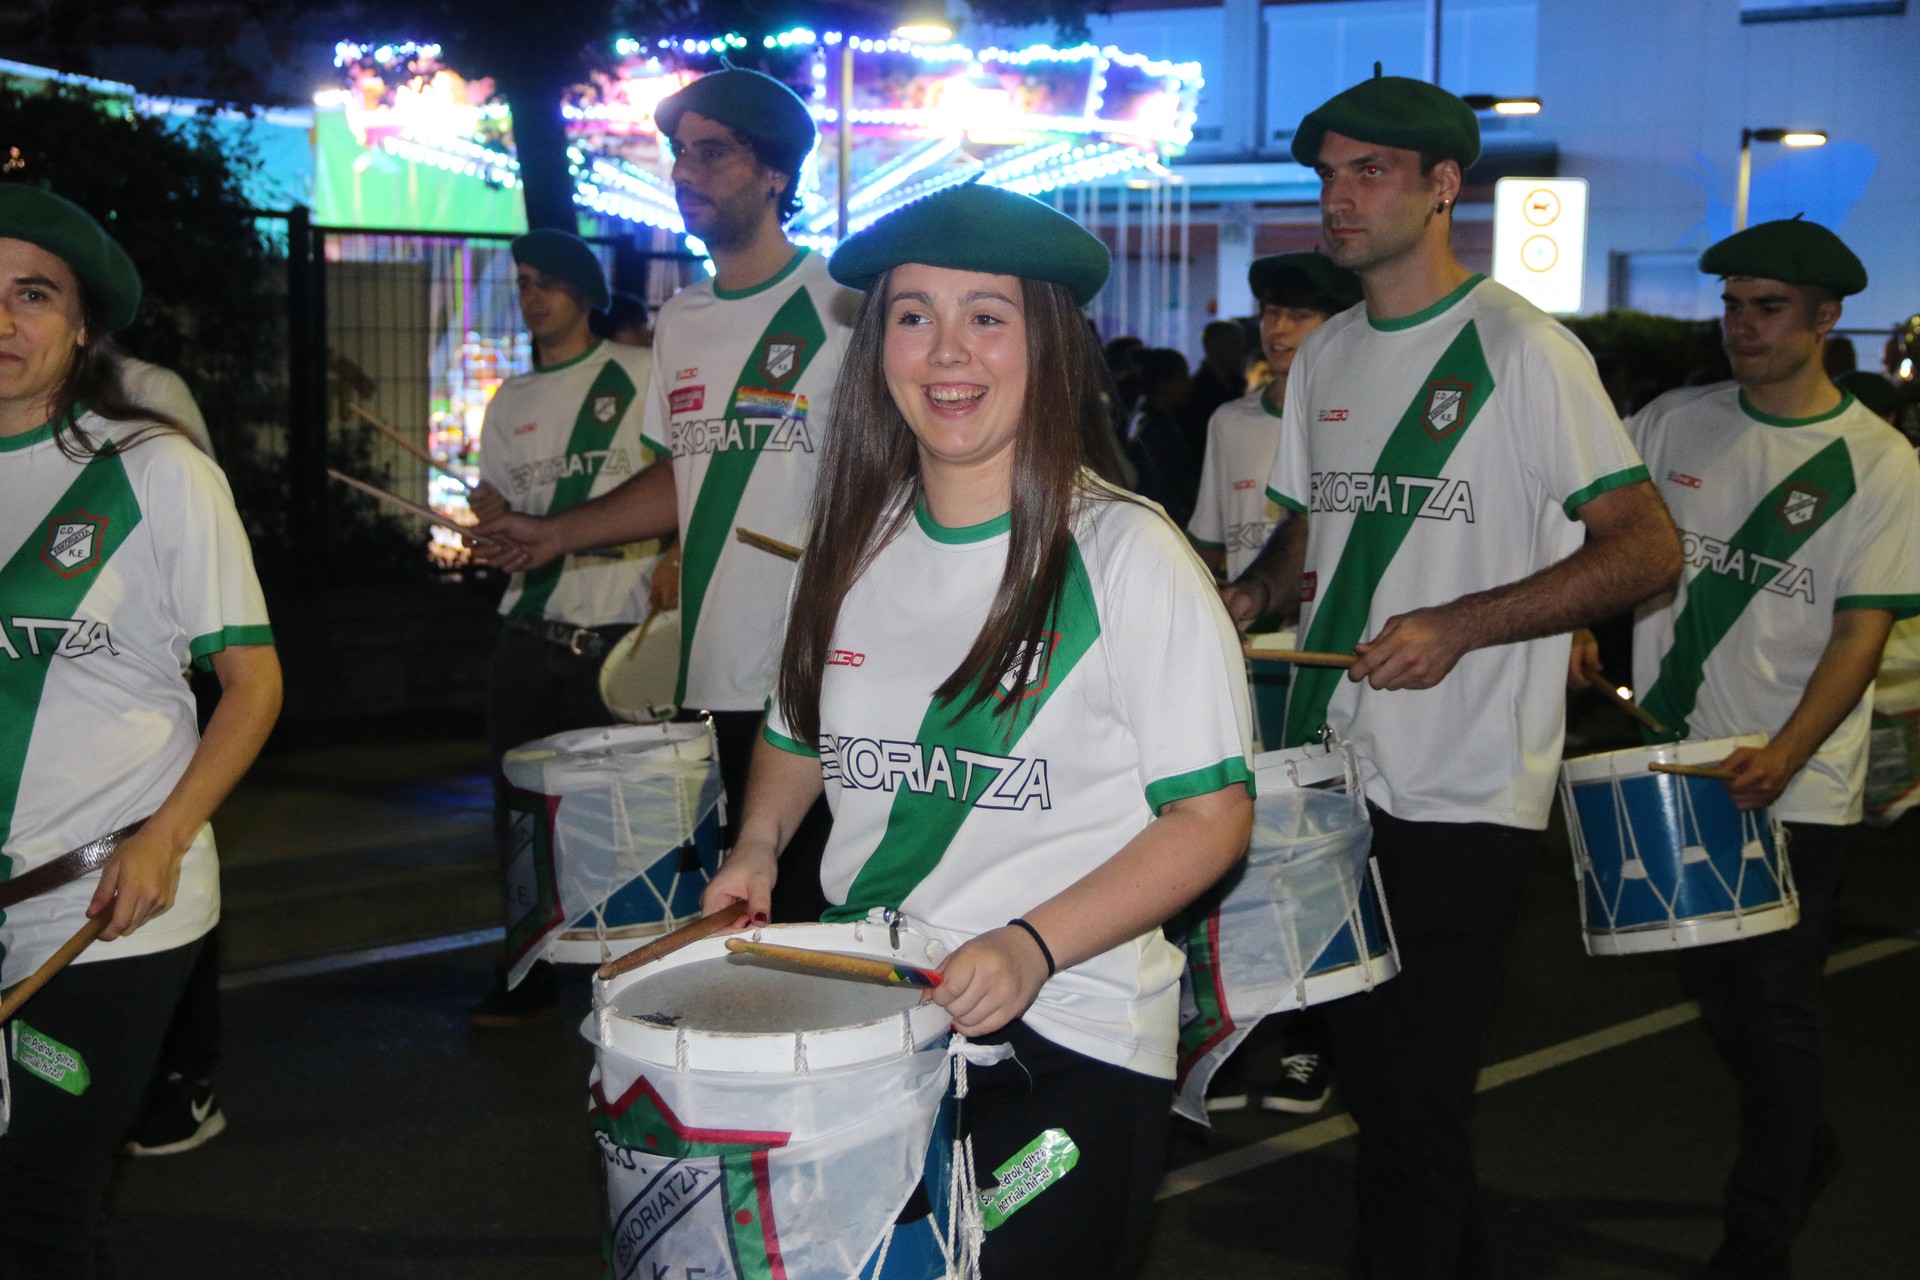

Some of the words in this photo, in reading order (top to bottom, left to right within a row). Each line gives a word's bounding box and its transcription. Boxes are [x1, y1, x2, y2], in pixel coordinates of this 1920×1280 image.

[1680, 528, 1816, 604] ORIATZA
[41, 1060, 64, 1080] hitza!
[1000, 1166, 1023, 1187] edrok
[995, 1187, 1027, 1214] herriak
[616, 1165, 710, 1269] ESKORIATZA
